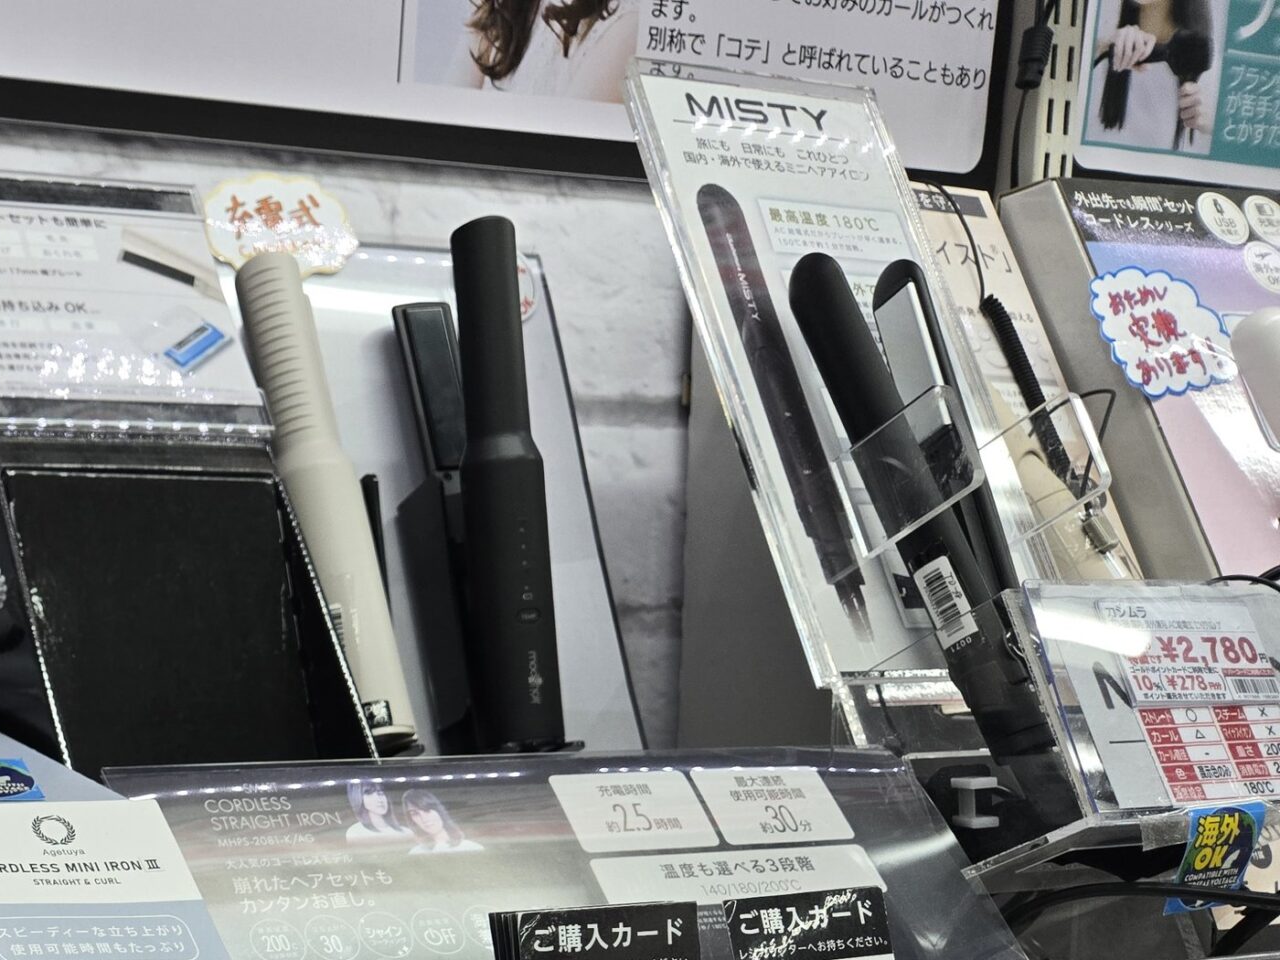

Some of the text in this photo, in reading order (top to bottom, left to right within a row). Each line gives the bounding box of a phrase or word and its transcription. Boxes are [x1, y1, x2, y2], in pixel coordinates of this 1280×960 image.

[647, 26, 986, 90] 別称で「コテ」と呼ばれていることもあり
[685, 92, 827, 131] MISTY
[596, 783, 653, 797] 充電時間
[729, 788, 806, 802] 使用可能時間
[204, 796, 292, 814] CORDLESS
[210, 810, 343, 832] STRAIGHT IRON
[1195, 812, 1240, 848] 海外
[42, 848, 85, 858] Agetuya
[65, 862, 100, 873] MINI
[104, 860, 142, 872] IRON
[660, 855, 816, 880] 温度も選べる3段階
[33, 878, 82, 886] STRAIGHT
[94, 877, 122, 886] CURL
[232, 868, 393, 895] 崩れたヘアセットも
[240, 891, 376, 915] カンタンお直し。
[738, 897, 873, 937] ご購入カード
[534, 917, 684, 954] ご購入カード
[10, 941, 185, 957] 使用可能時間もたっぷり
